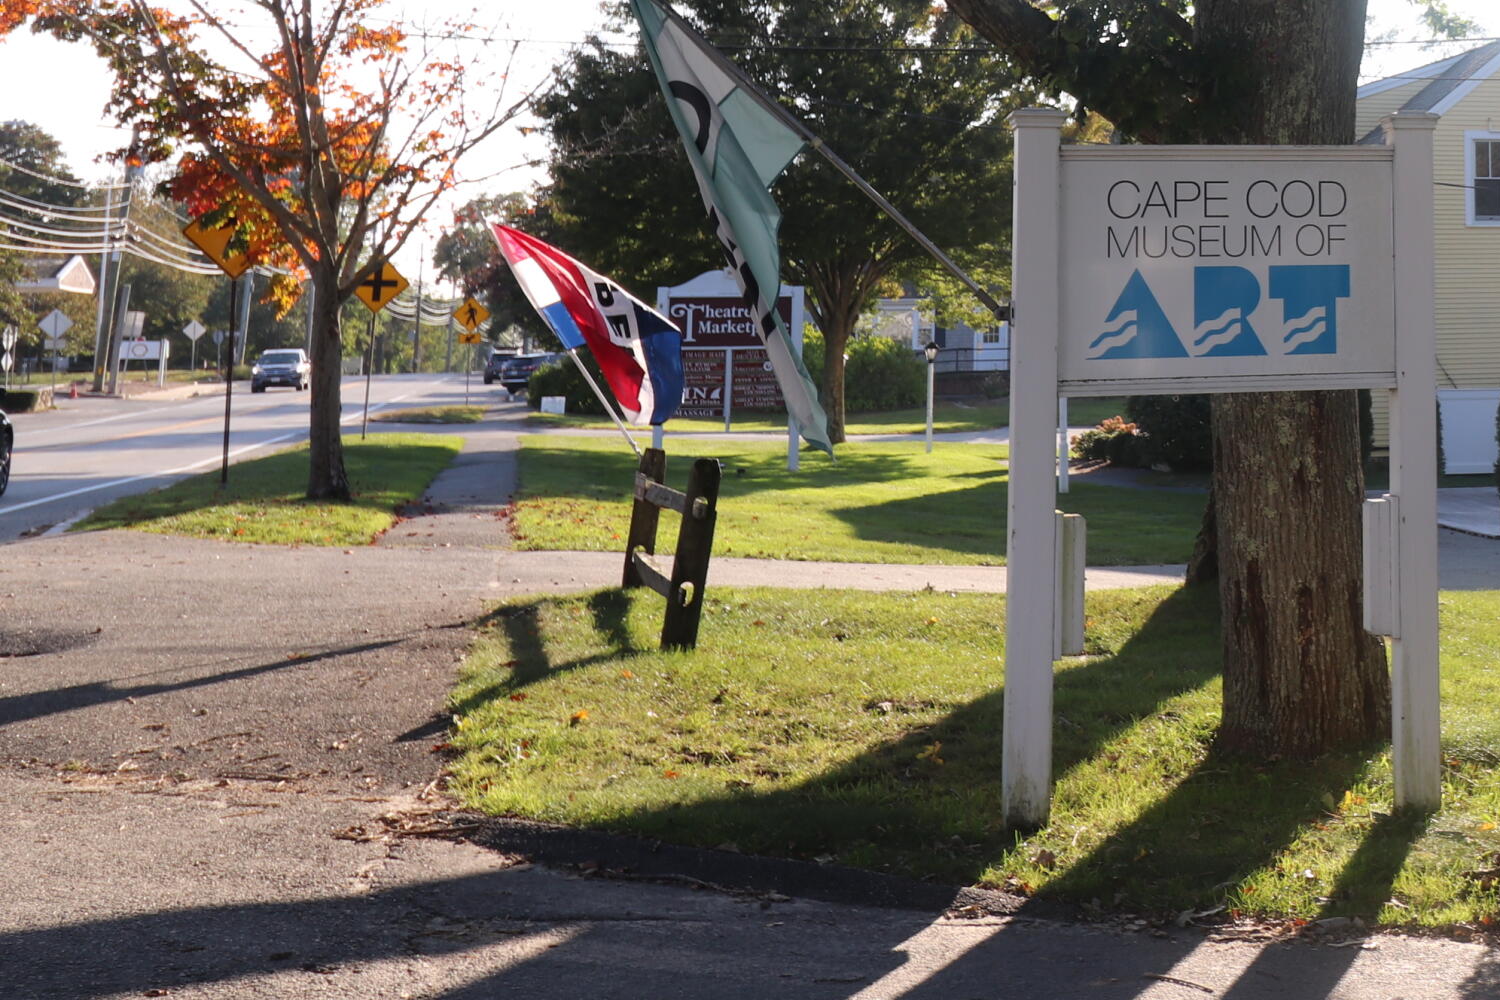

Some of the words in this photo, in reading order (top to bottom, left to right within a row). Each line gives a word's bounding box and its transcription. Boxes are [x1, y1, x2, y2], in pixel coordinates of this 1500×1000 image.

[1107, 180, 1230, 219] CAPE
[1246, 180, 1348, 219] COD
[1107, 224, 1282, 258] MUSEUM
[1295, 224, 1348, 257] OF
[1085, 264, 1351, 361] ART
